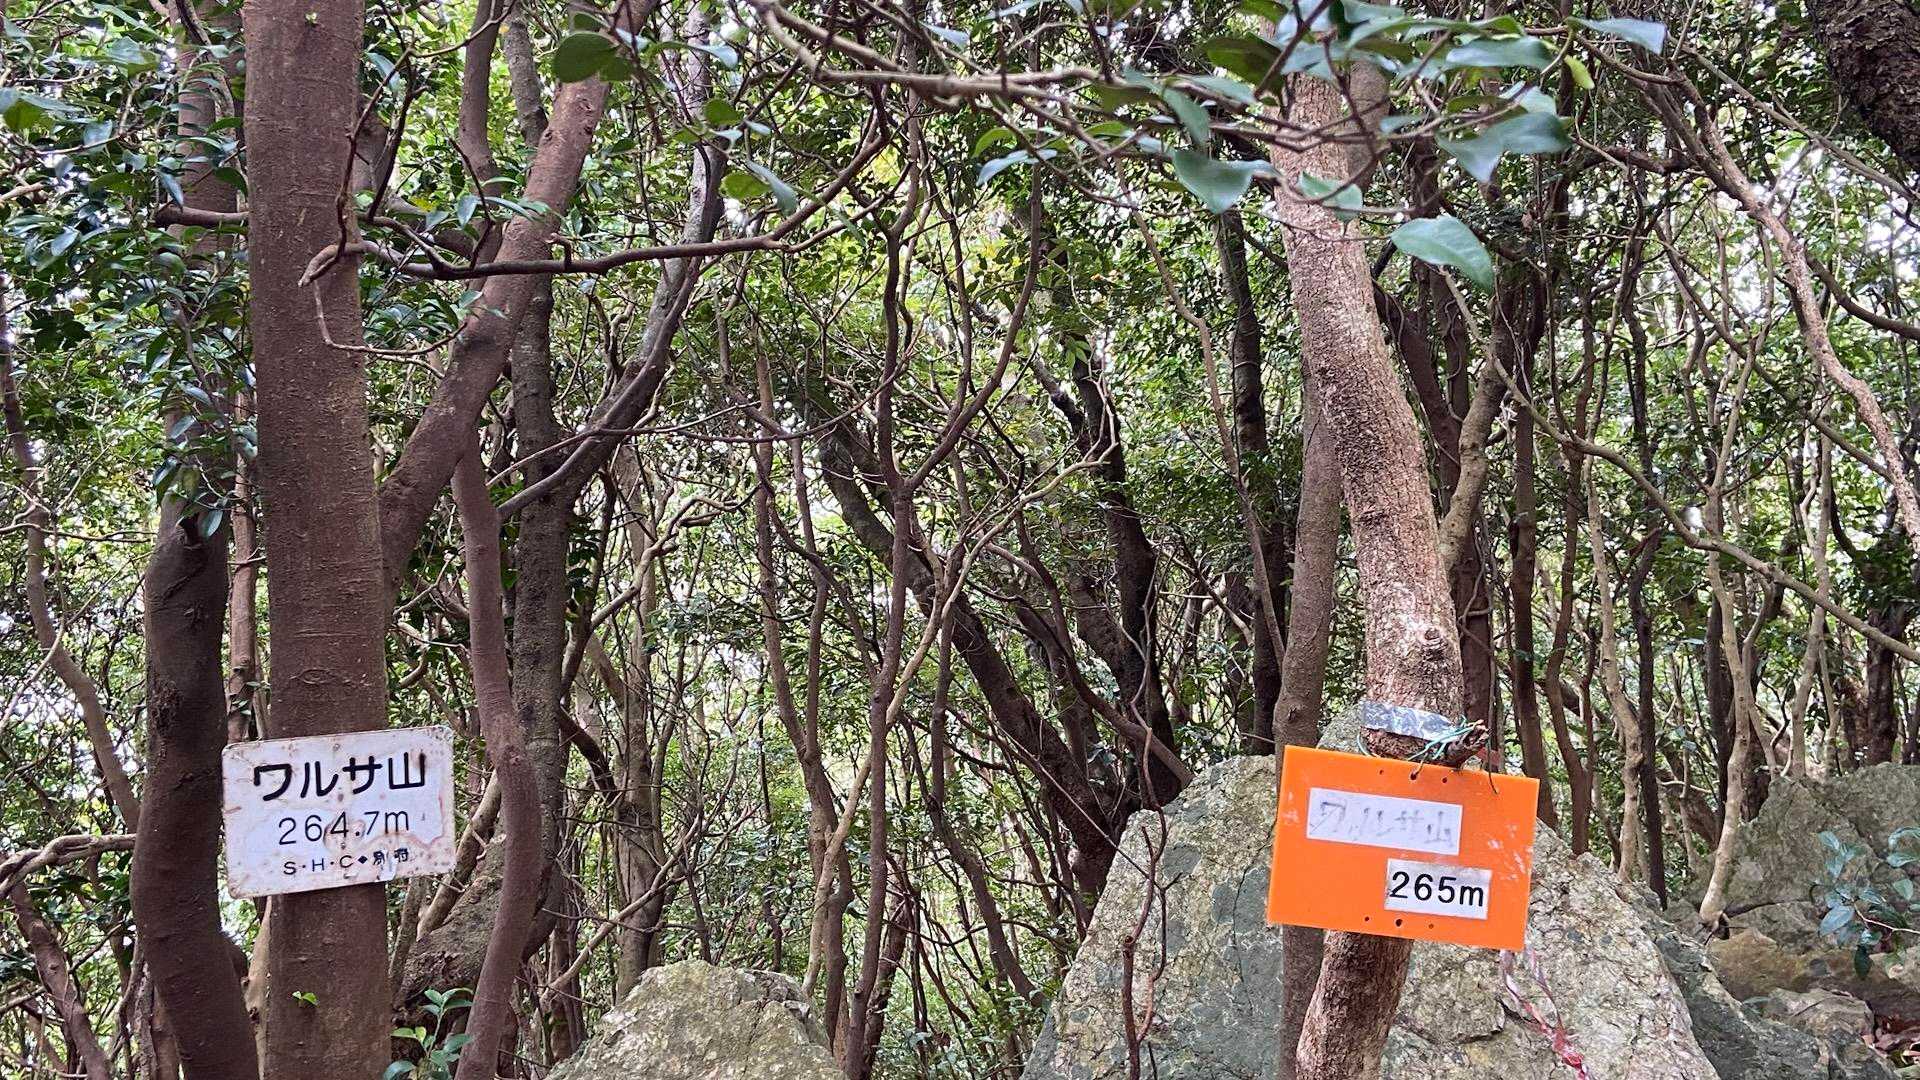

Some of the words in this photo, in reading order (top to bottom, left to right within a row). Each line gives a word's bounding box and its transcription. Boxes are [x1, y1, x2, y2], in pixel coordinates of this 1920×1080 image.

[253, 751, 426, 801] ワルサ山
[278, 810, 409, 845] 264.7m
[1389, 871, 1485, 907] 265m
